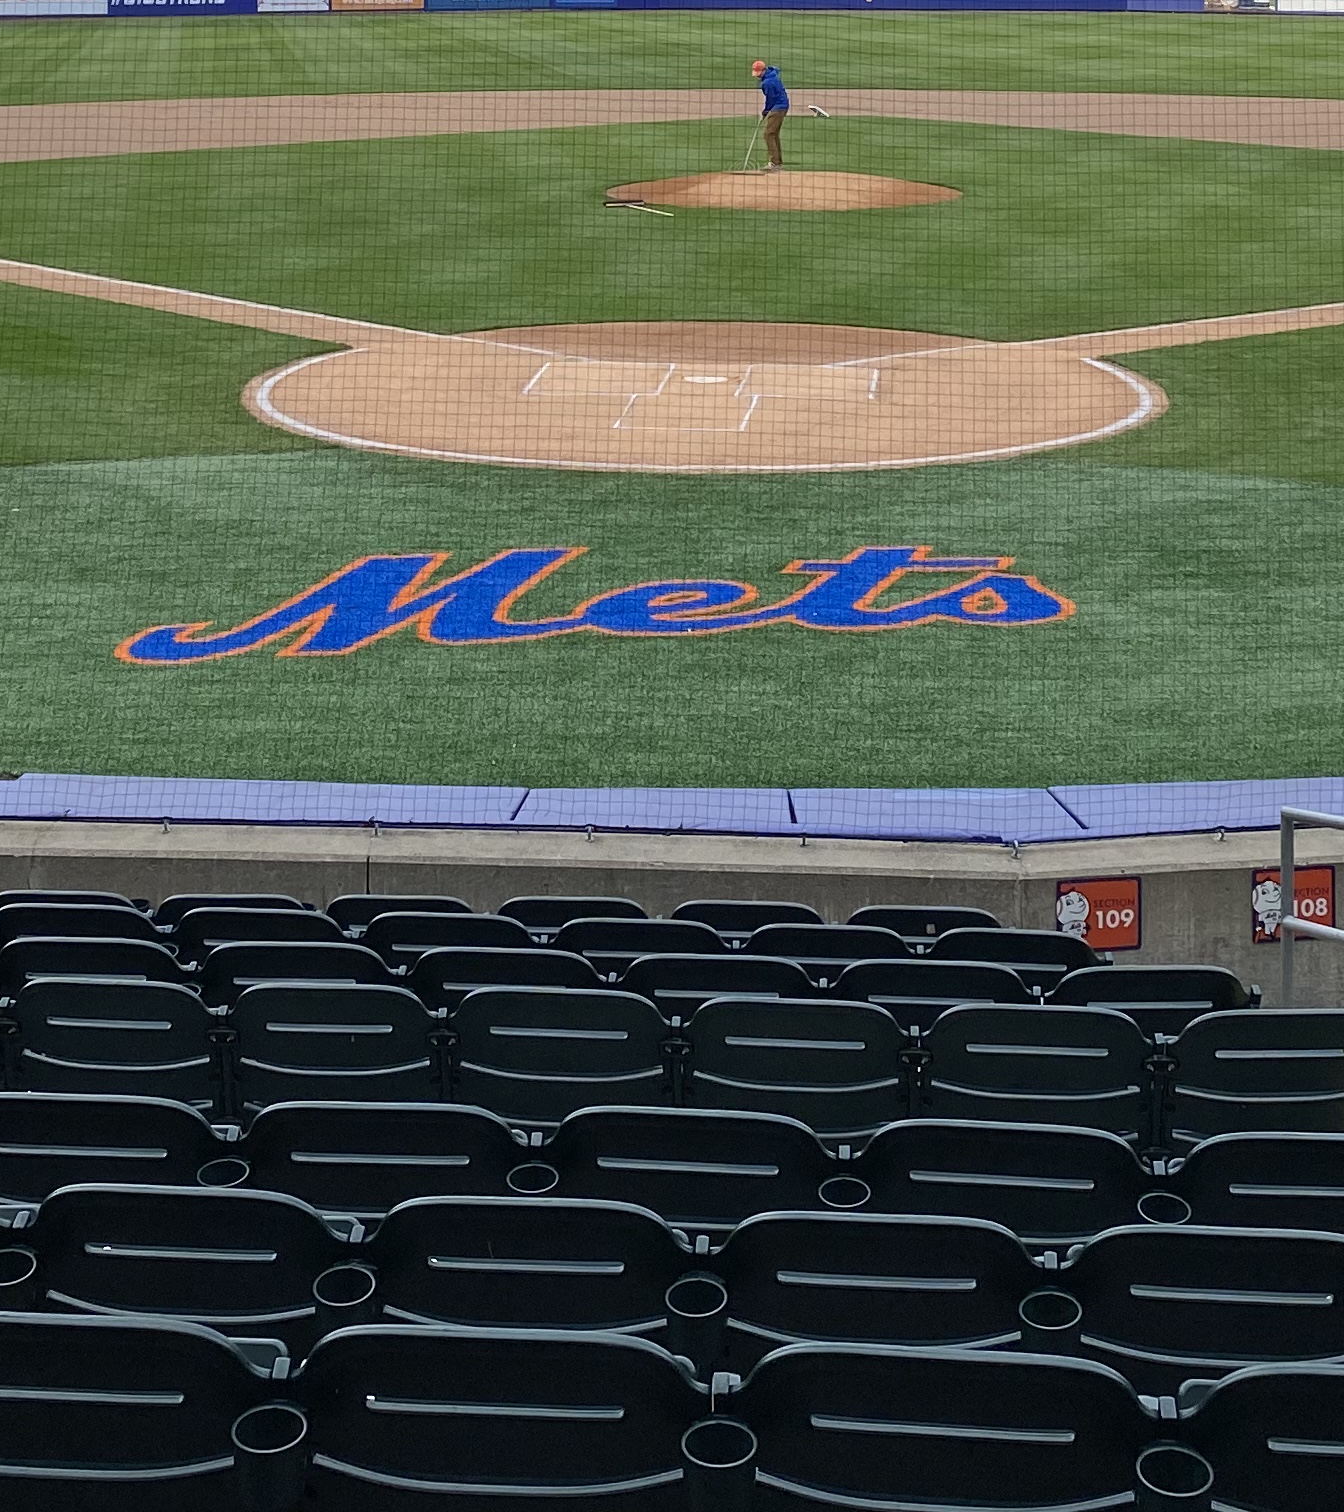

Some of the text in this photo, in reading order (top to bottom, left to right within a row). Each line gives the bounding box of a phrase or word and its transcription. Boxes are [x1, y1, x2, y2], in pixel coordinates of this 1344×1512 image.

[115, 545, 1077, 666] Mets
[1293, 887, 1329, 898] ECTION
[1093, 897, 1136, 909] SECTION
[1293, 898, 1329, 918] 108
[1095, 909, 1135, 930] 109
